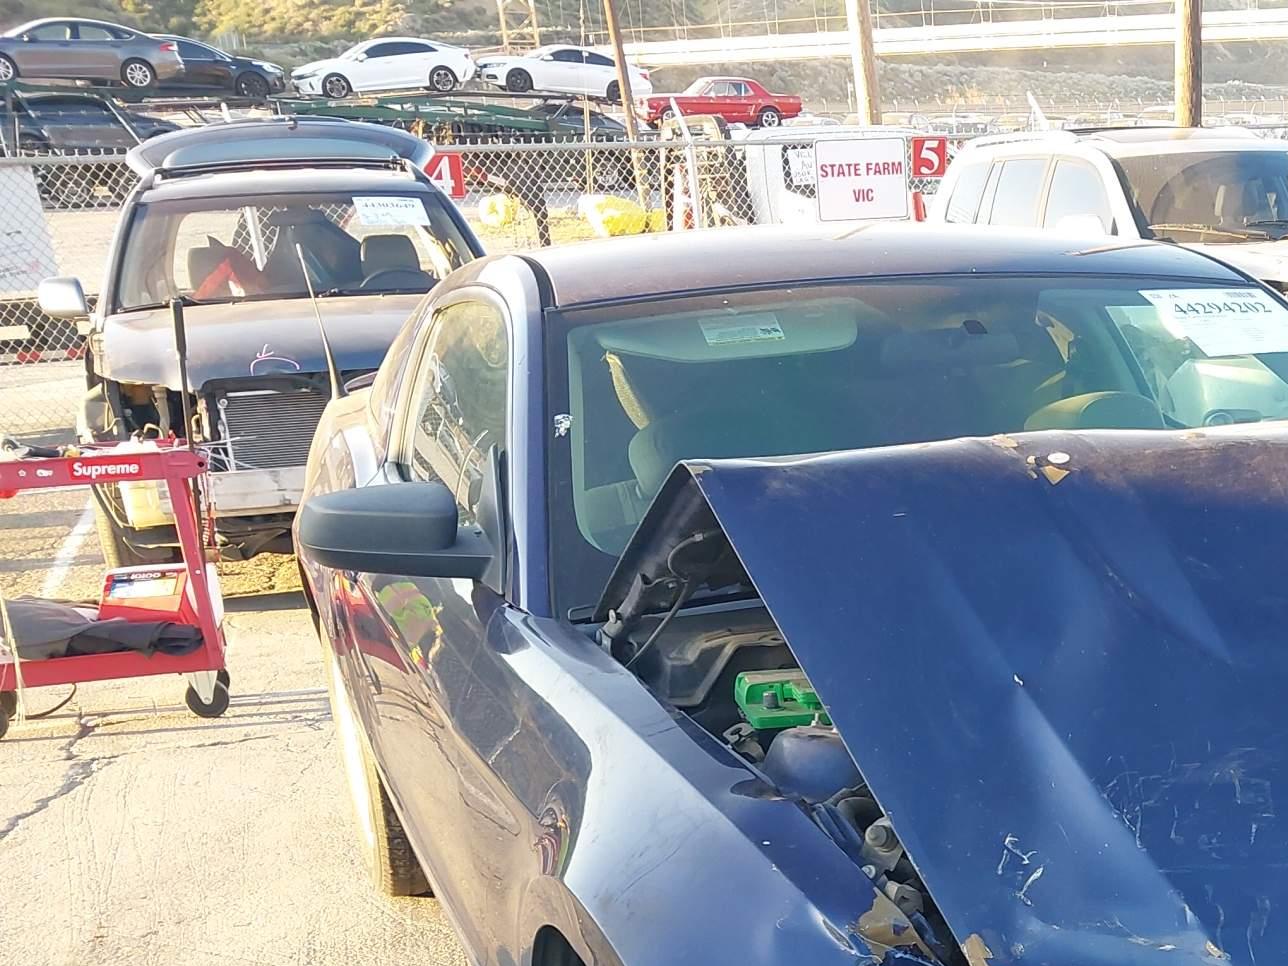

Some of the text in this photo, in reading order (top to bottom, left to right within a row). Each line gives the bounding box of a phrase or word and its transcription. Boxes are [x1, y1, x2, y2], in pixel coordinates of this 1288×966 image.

[919, 140, 940, 175] 5
[430, 155, 456, 195] 4
[820, 162, 862, 178] STATE
[866, 161, 903, 177] FARM
[853, 188, 874, 203] VIC
[1174, 301, 1272, 315] 44294202
[73, 462, 140, 479] Supreme
